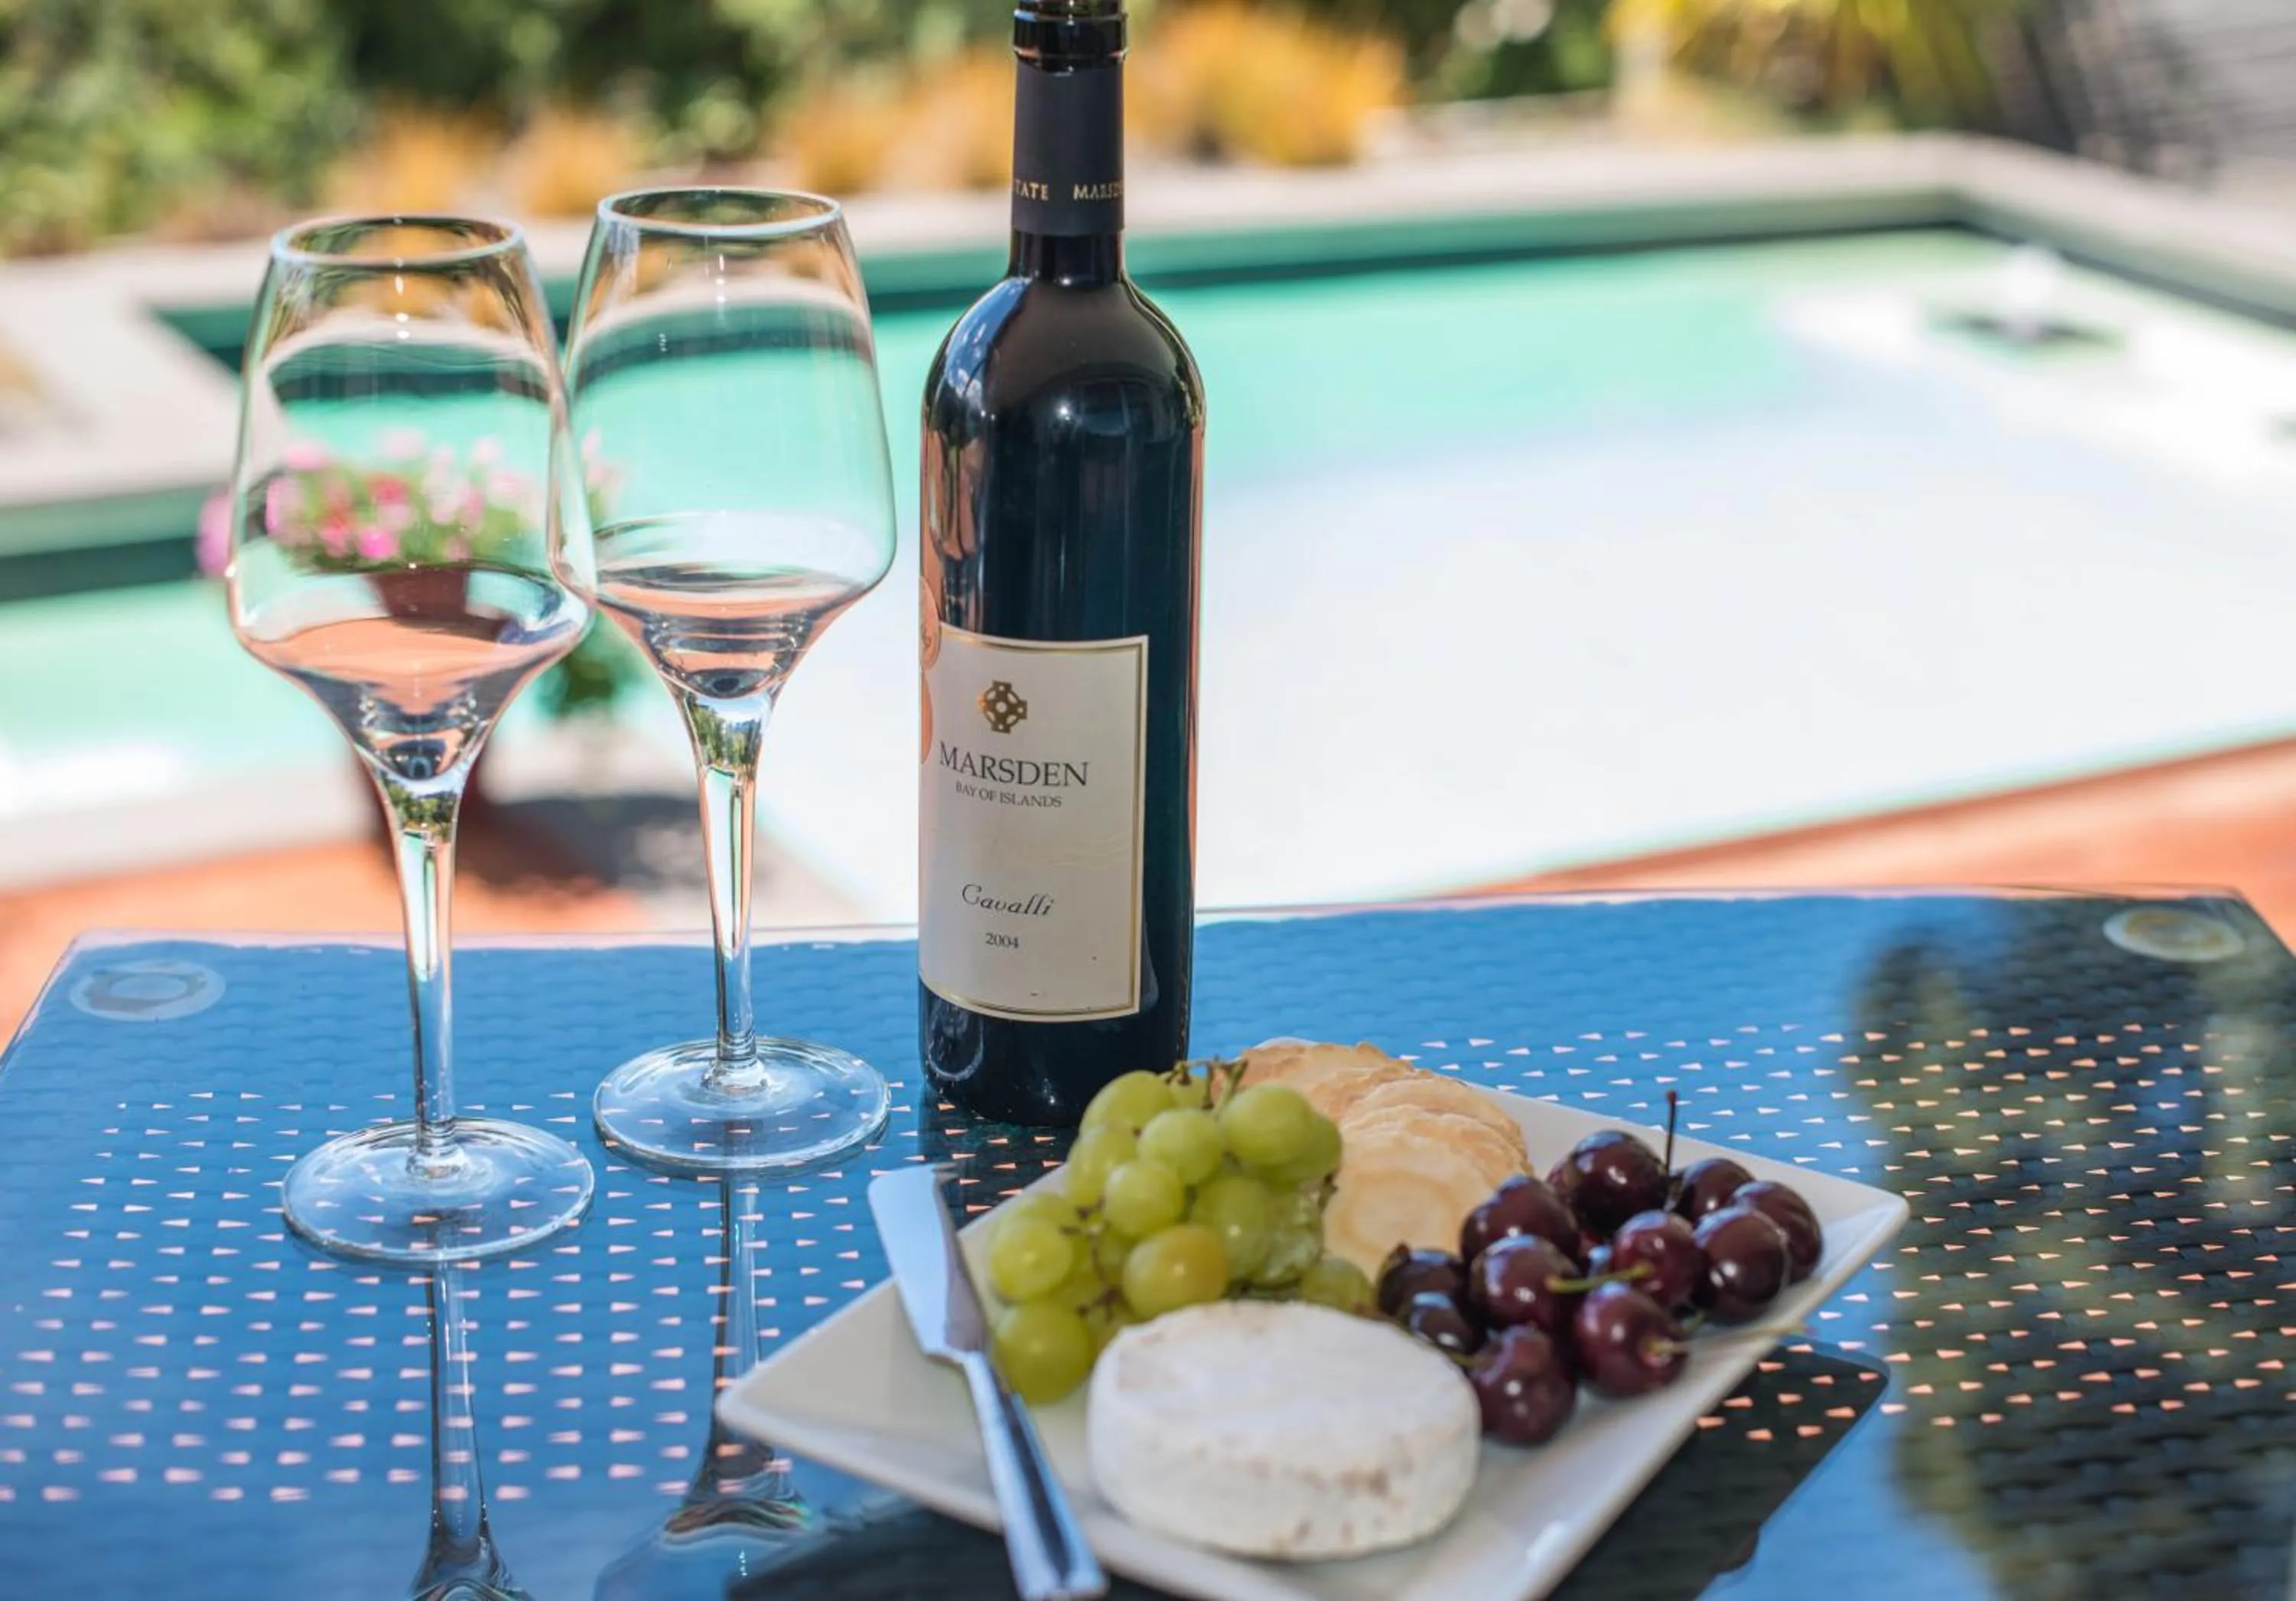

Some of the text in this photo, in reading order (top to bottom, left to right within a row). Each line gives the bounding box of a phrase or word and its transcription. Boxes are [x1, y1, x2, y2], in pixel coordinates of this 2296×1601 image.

[1015, 178, 1123, 201] TATE MARSD
[940, 740, 1089, 787] MARSDEN
[956, 781, 1062, 808] BAY OF ISLANDS
[962, 883, 1054, 916] Cavalli
[986, 932, 1019, 949] 2004
